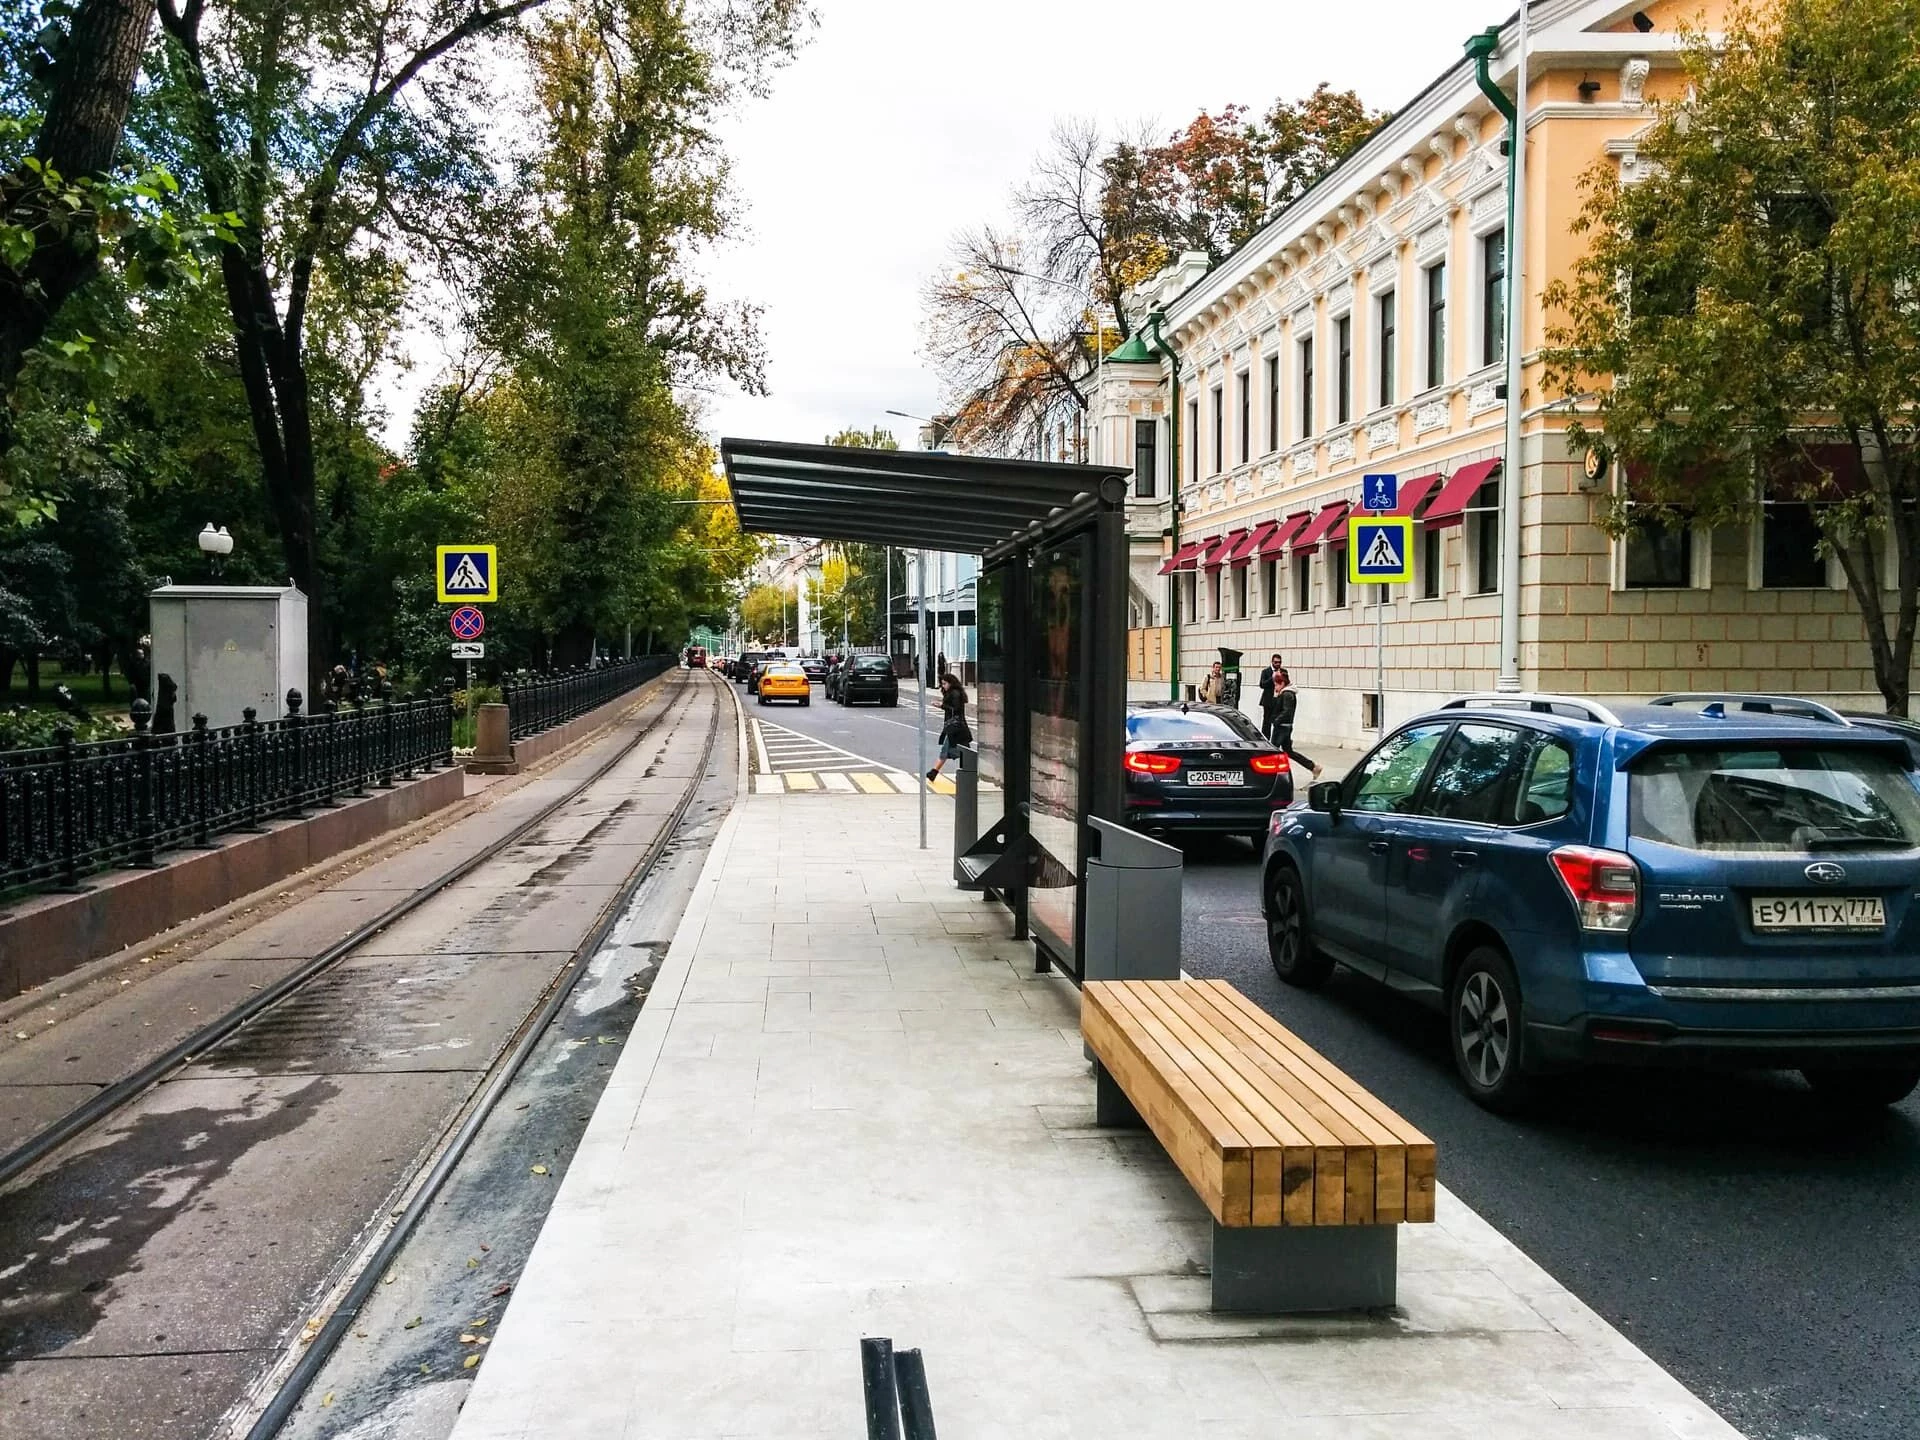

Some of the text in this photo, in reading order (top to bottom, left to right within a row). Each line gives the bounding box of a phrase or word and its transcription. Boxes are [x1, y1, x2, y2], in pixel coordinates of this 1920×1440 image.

[1660, 893, 1723, 902] SUBARU
[1760, 899, 1877, 922] Е911ТХ 777
